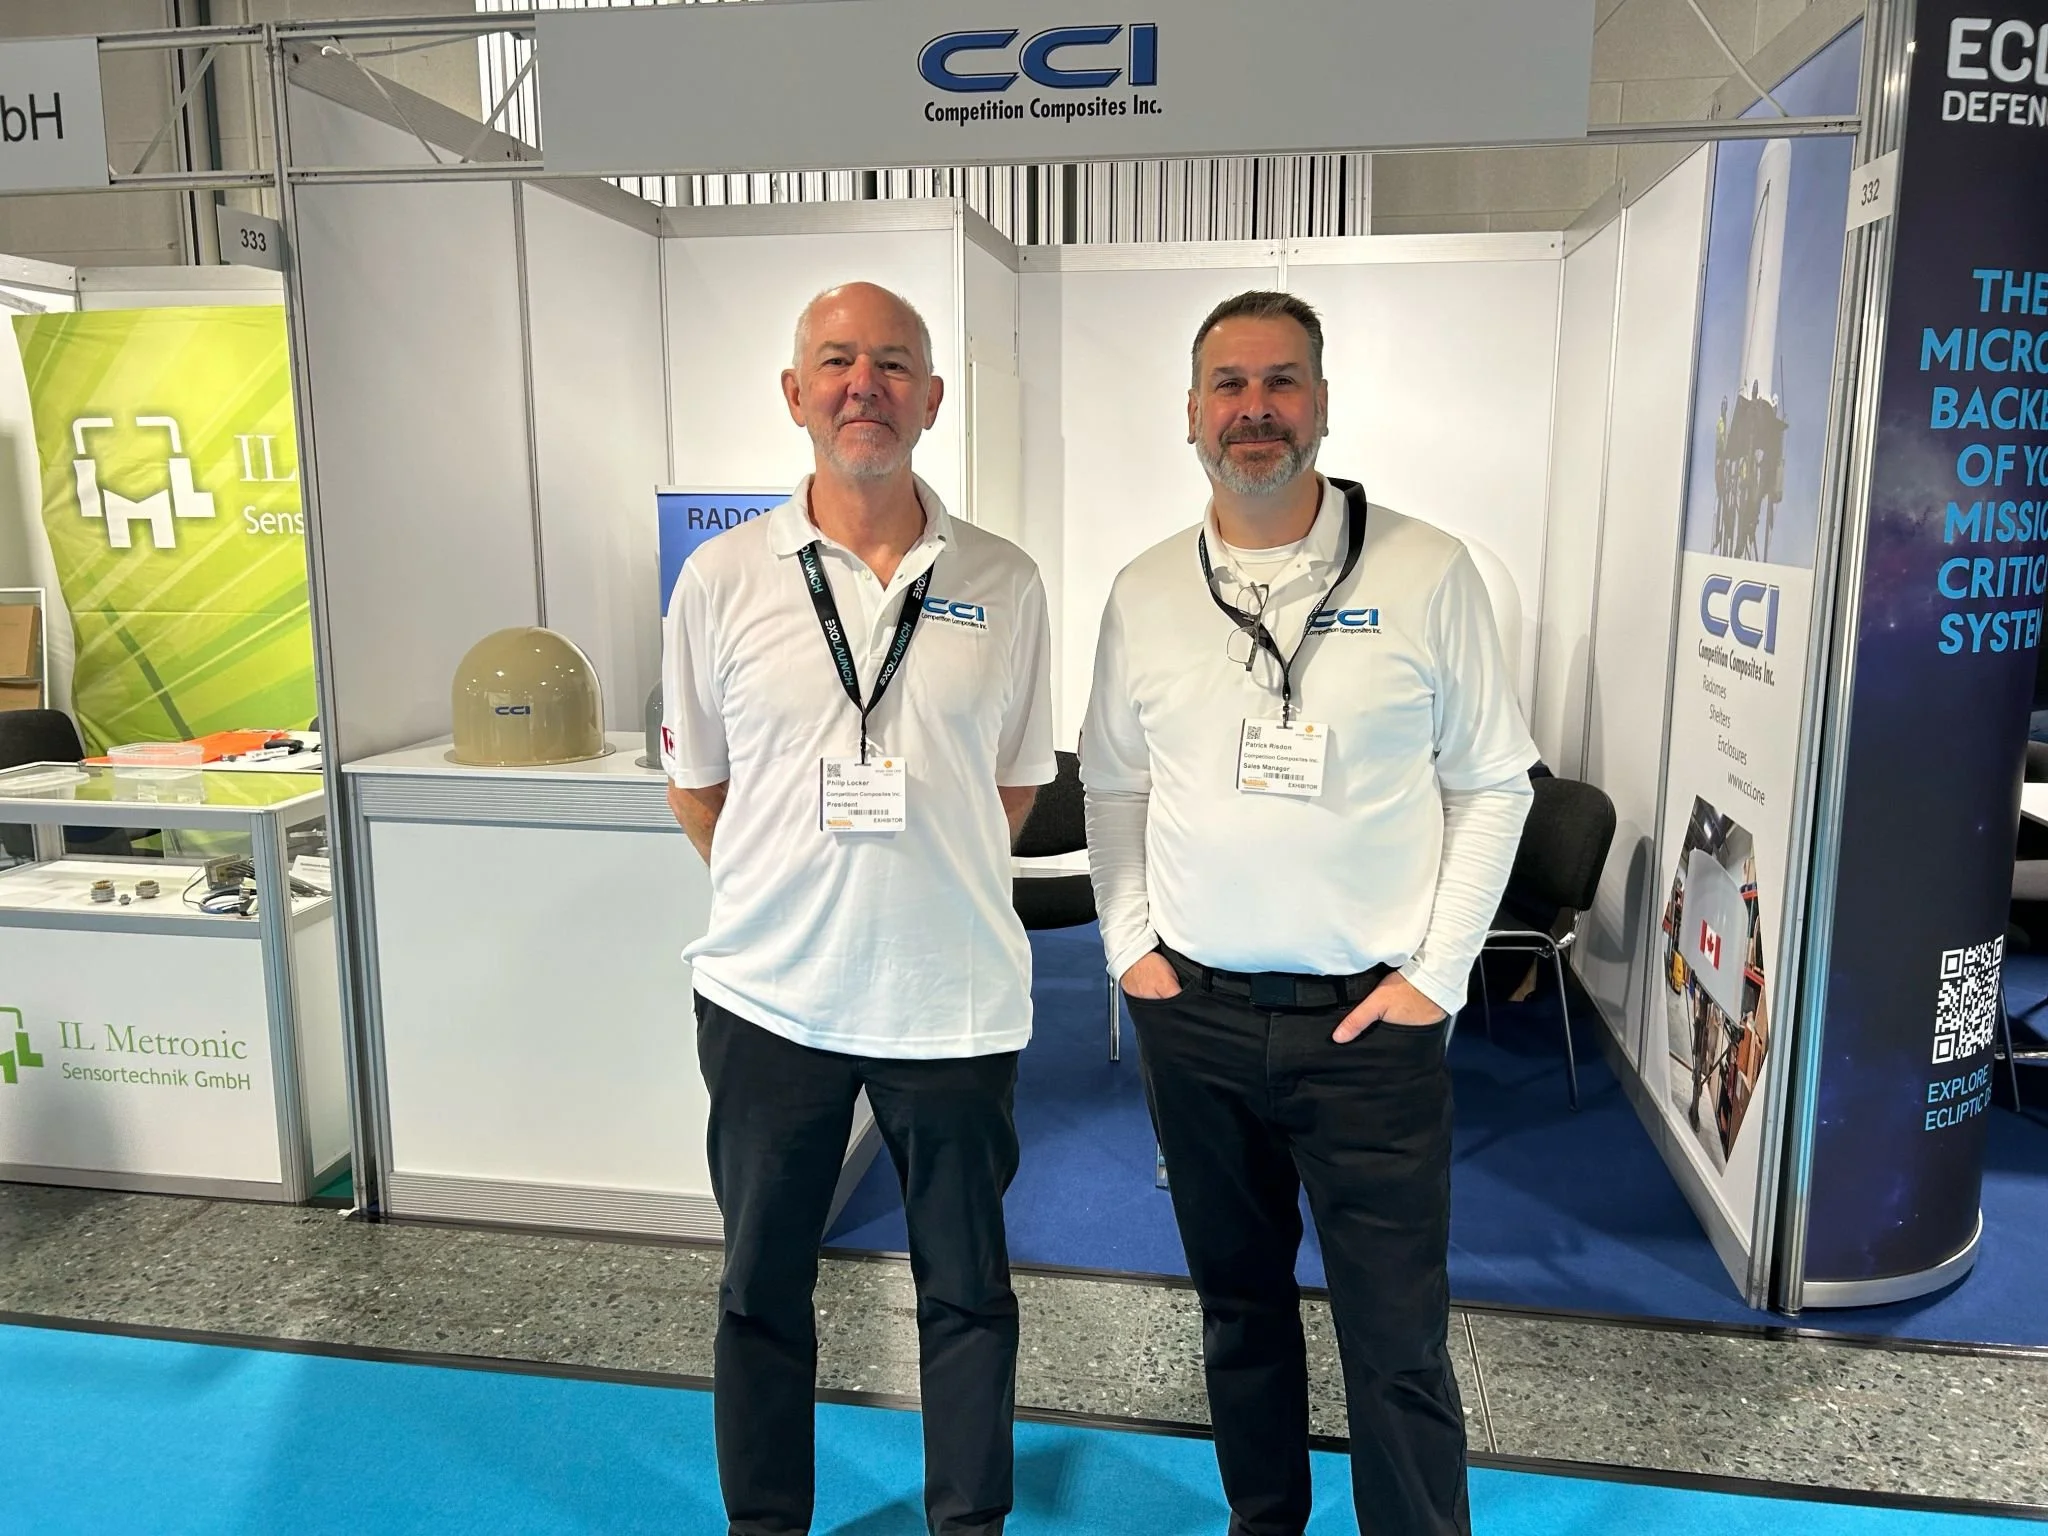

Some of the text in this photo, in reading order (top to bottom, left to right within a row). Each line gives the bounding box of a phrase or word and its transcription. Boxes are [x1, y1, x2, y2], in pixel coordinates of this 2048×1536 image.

[917, 23, 1158, 93] CCI
[924, 94, 1162, 127] Competition Composites Inc.
[1942, 90, 2048, 127] DEFEN
[1861, 178, 1881, 206] 332
[241, 228, 267, 252] 333
[1972, 269, 2048, 315] THE
[233, 433, 297, 482] IL
[1956, 443, 2016, 487] OF
[687, 507, 772, 530] RADO
[922, 597, 985, 622] CCI
[1700, 573, 1780, 655] CCI
[824, 618, 854, 686] EXOLAUNCH
[880, 621, 912, 687] EXOLAUNCH
[1698, 638, 1775, 687] Competition Composites Inc.
[1702, 674, 1727, 700] Radomes
[495, 705, 531, 716] CCI
[1709, 703, 1731, 729] Shelters
[1243, 762, 1261, 770] Sales
[1717, 734, 1748, 766] Enclosures
[826, 779, 846, 787] Philip
[1288, 782, 1318, 790] EXHIBITOR
[1727, 771, 1766, 806] www.cci.one
[57, 1020, 248, 1060] IL Metronic
[62, 1062, 251, 1091] Sensortechnik GmbH
[1927, 1063, 1989, 1104] EXPLORE
[1924, 1092, 1984, 1131] ECLIPTIC
